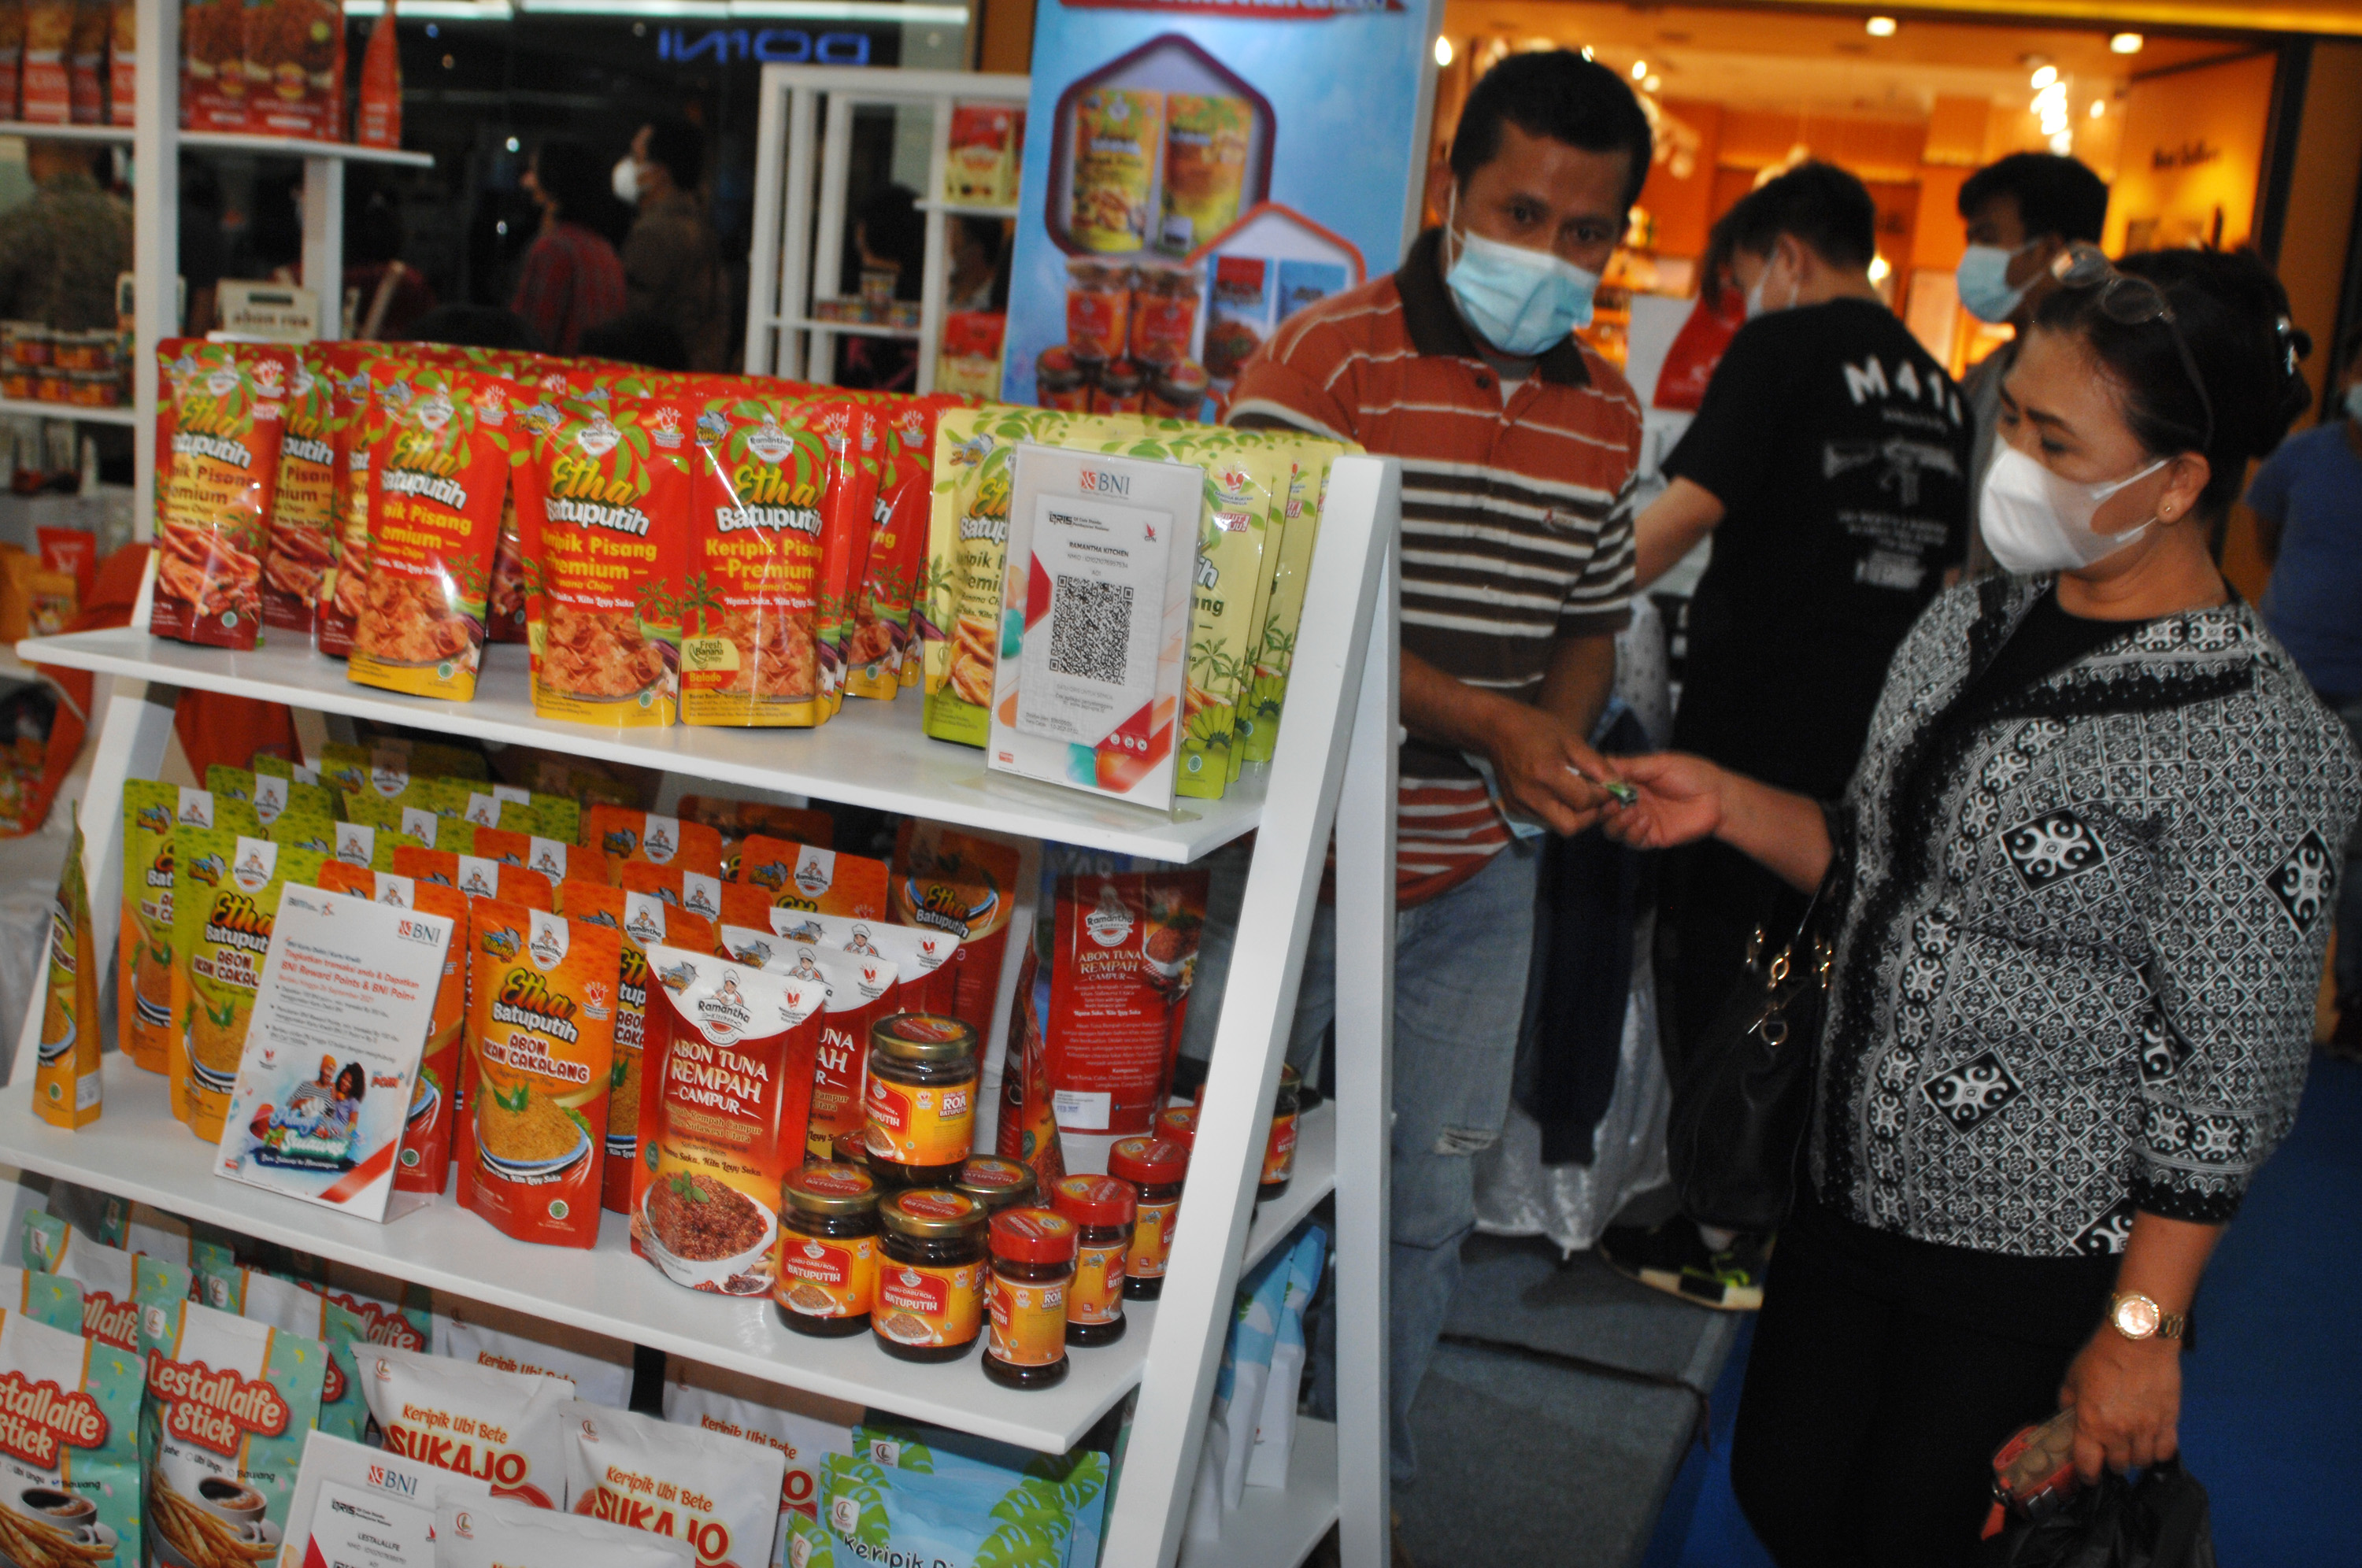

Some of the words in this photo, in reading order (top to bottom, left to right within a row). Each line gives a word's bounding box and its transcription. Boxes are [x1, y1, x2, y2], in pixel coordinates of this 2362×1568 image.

[551, 455, 641, 507] Etha
[731, 464, 821, 508] Etha
[1098, 473, 1131, 495] BNI
[590, 536, 657, 562] Pisang
[706, 538, 777, 560] Keripik
[1069, 542, 1102, 553] RAMANTHA
[1103, 547, 1129, 557] KITCHEN
[700, 641, 723, 649] Fresh
[690, 673, 722, 682] Balado
[924, 884, 967, 919] Etha
[413, 922, 442, 944] BNI
[916, 908, 970, 939] Batuputih
[1087, 915, 1134, 927] Ramantha
[205, 923, 269, 954] Batuput
[1079, 951, 1110, 963] ABON
[1113, 950, 1142, 960] TUNA
[1080, 961, 1138, 974] REMPAH
[217, 967, 260, 991] CAKAL
[281, 961, 298, 973] BNI
[299, 965, 331, 982] Reward
[334, 974, 361, 989] Points
[372, 983, 389, 996] BNI
[500, 967, 578, 1019] Etha
[492, 1000, 579, 1045] Batuputih
[698, 1000, 750, 1024] Ramantha
[508, 1031, 550, 1057] ABON
[509, 1052, 590, 1084] CAKALANG
[672, 1039, 713, 1064] ABON
[719, 1048, 769, 1082] TUNA
[672, 1058, 763, 1104] REMPAH
[942, 1094, 967, 1111] ROA
[687, 1120, 724, 1137] Sulawesi
[725, 1130, 751, 1144] Utara
[727, 1119, 763, 1135] Campur
[741, 1166, 762, 1177] Suka
[787, 1263, 842, 1283] BATUPUTIH
[885, 1292, 938, 1311] BATUPUTIH
[1044, 1291, 1062, 1304] ROA
[173, 1402, 236, 1448] Stick
[403, 1404, 450, 1429] Keripik
[454, 1417, 476, 1435] Ubi
[479, 1424, 509, 1444] Bete
[389, 1424, 527, 1485] SUKAJO
[62, 1479, 101, 1491] Bawang
[236, 1469, 276, 1483] Bawang
[385, 1470, 418, 1496] BNI
[606, 1466, 654, 1494] Keripik
[657, 1482, 678, 1503] Ubi
[681, 1490, 713, 1513] Bete
[843, 1534, 925, 1568] Keripik
